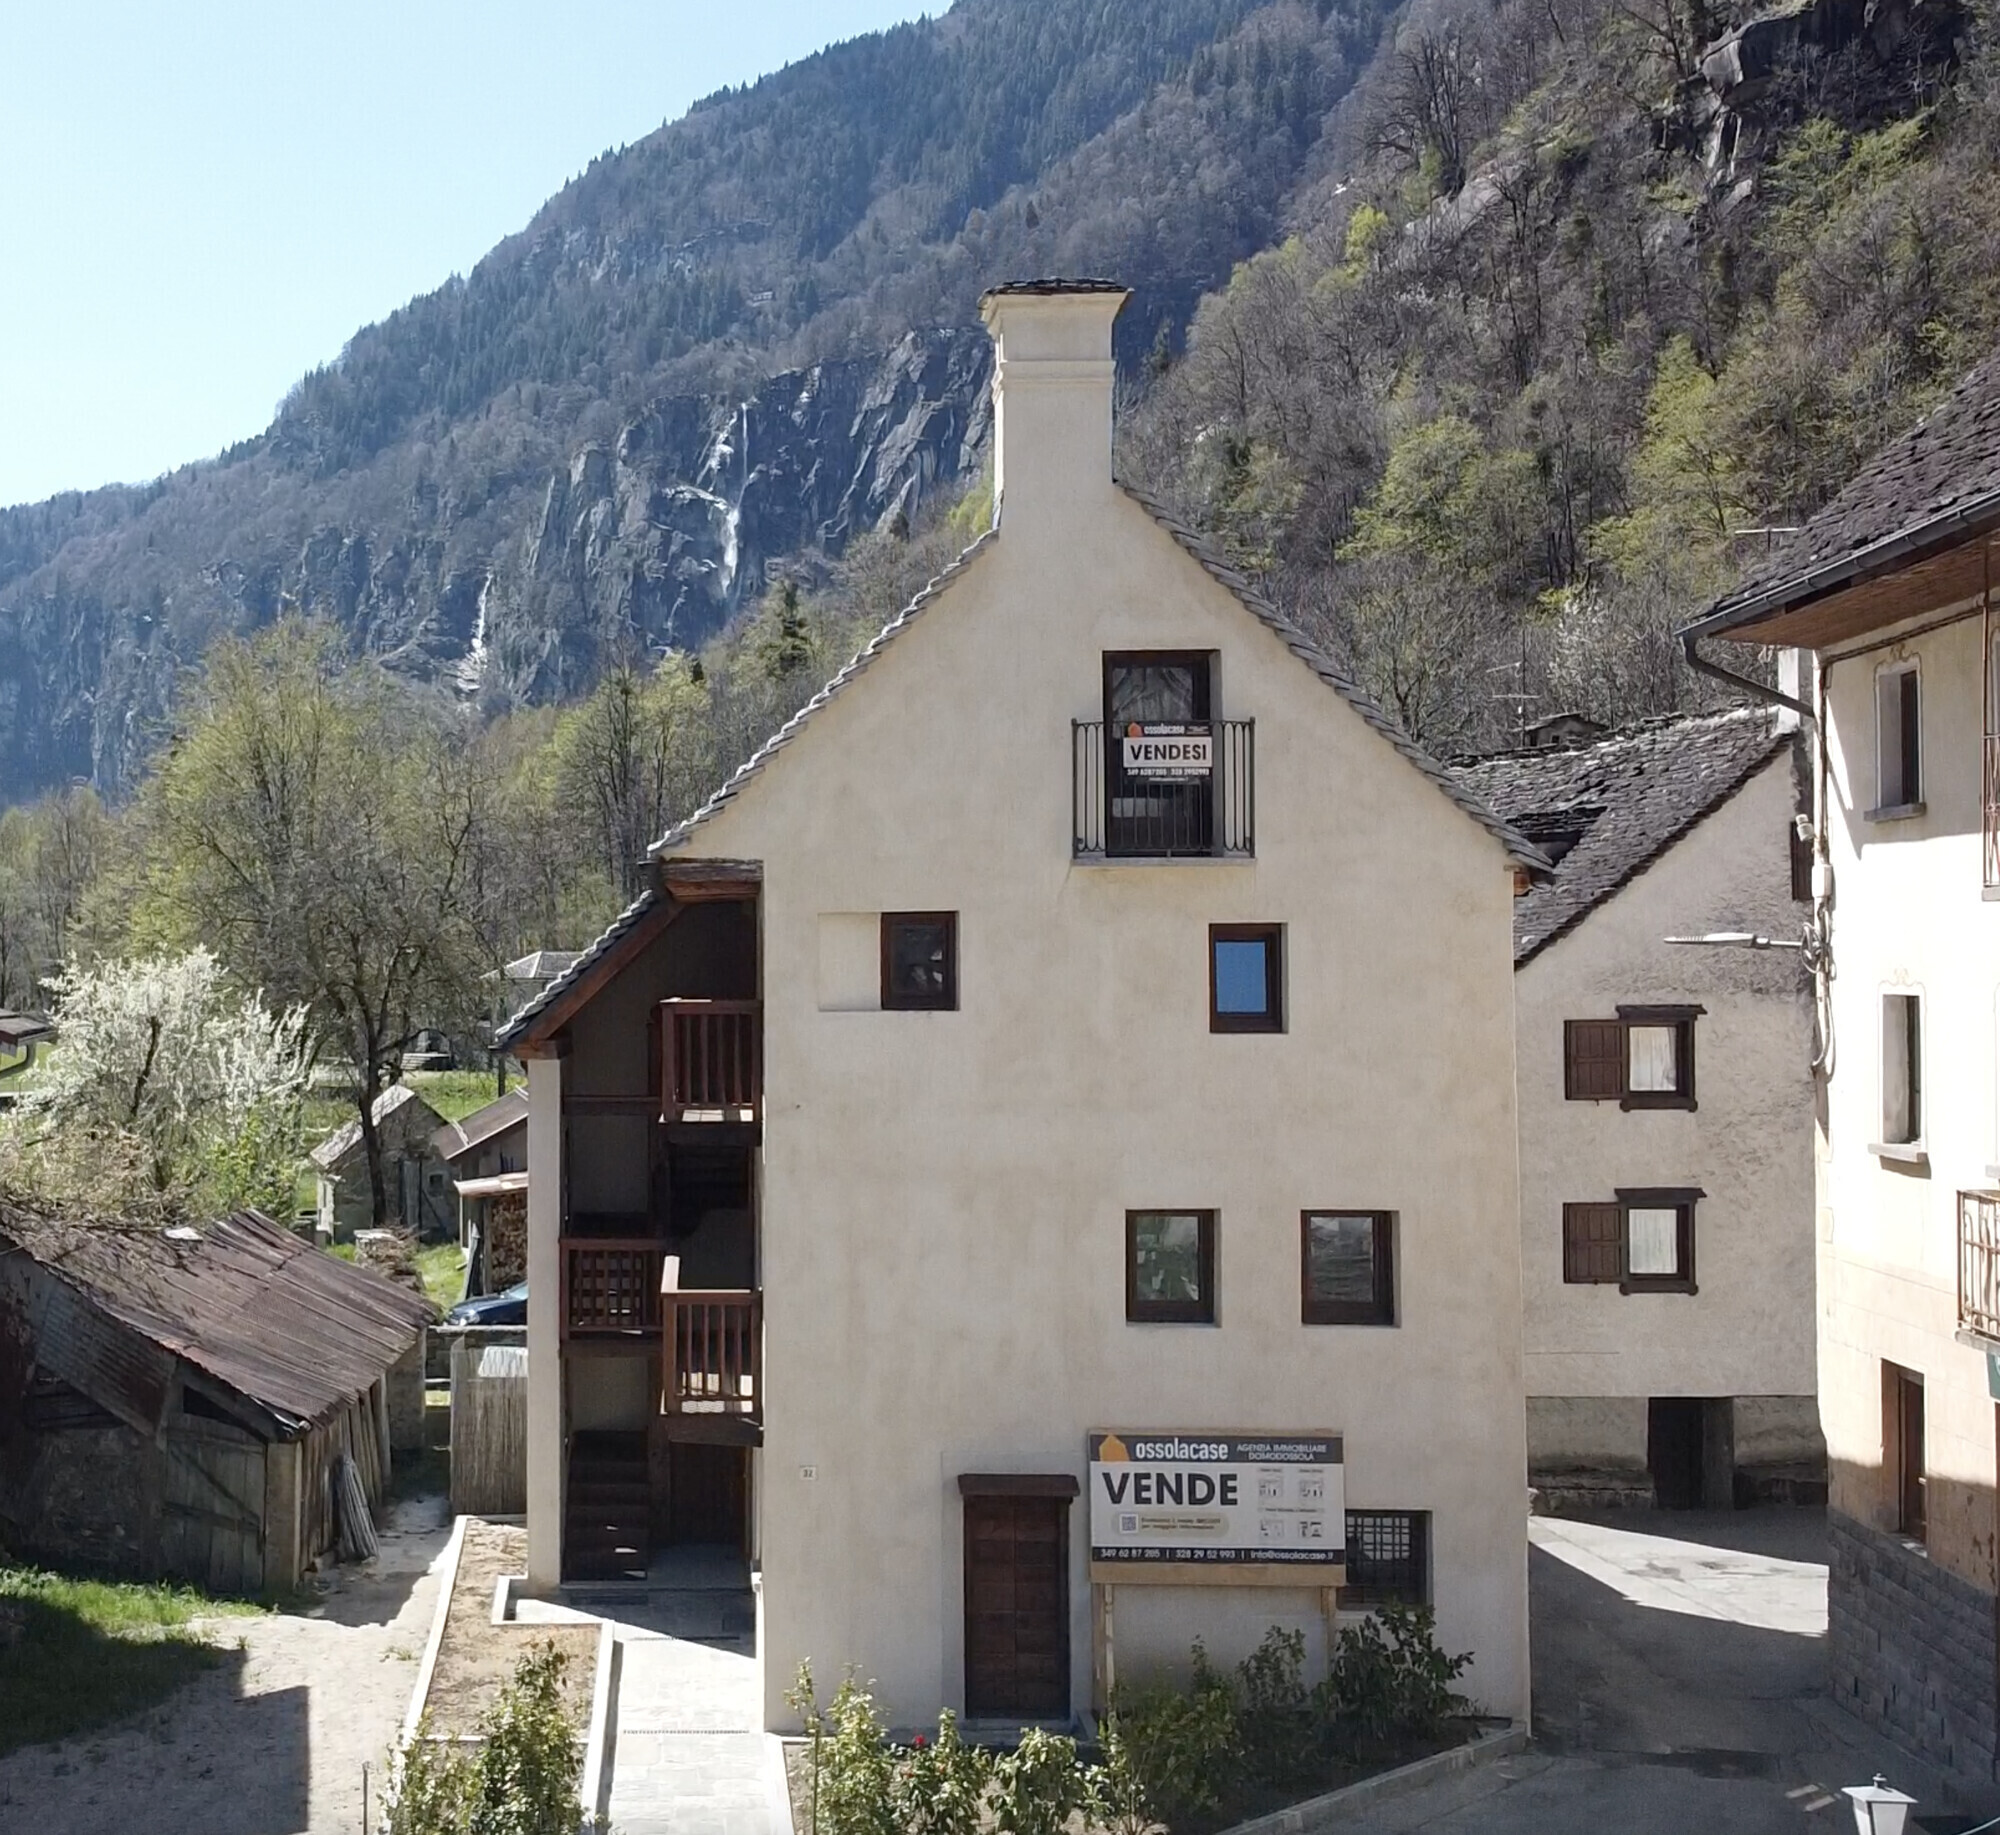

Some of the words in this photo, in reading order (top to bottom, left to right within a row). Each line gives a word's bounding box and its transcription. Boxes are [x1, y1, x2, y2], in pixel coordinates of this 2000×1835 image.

[1130, 744, 1207, 760] VENDESI
[1136, 1437, 1228, 1459] ossolacase
[1236, 1443, 1271, 1452] AGENZIA
[1273, 1444, 1327, 1453] IMMOBILIARE
[1248, 1452, 1315, 1461] DOMODOSSOLA
[1102, 1472, 1238, 1505] VENDE
[1100, 1548, 1117, 1558] 349
[1118, 1548, 1129, 1558] 62
[1193, 1549, 1205, 1559] 29
[1219, 1549, 1236, 1559] 993
[1250, 1550, 1334, 1560] info@ossolacase.it
